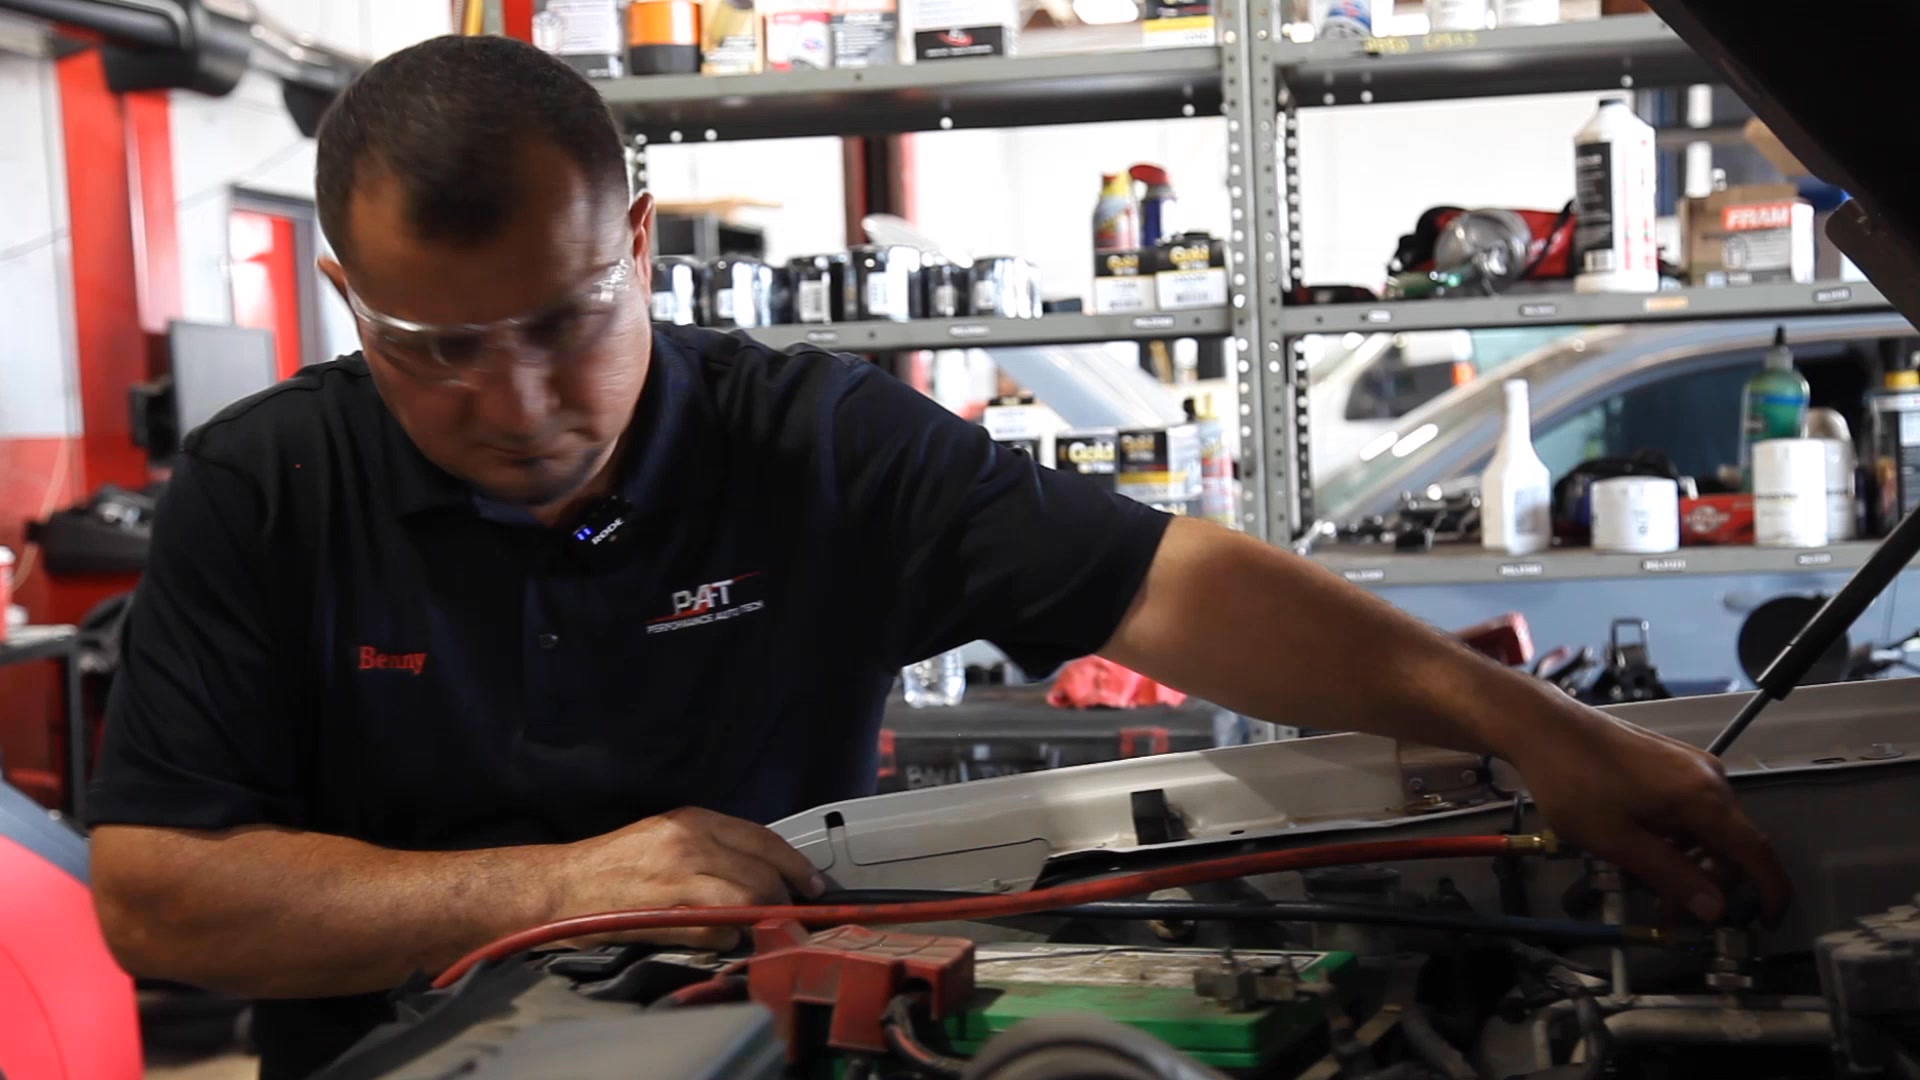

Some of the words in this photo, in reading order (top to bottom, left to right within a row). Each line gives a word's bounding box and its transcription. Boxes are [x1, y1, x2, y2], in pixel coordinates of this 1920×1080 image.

[1727, 205, 1790, 229] FRAM
[1070, 440, 1115, 463] Gold
[358, 645, 428, 676] Benny
